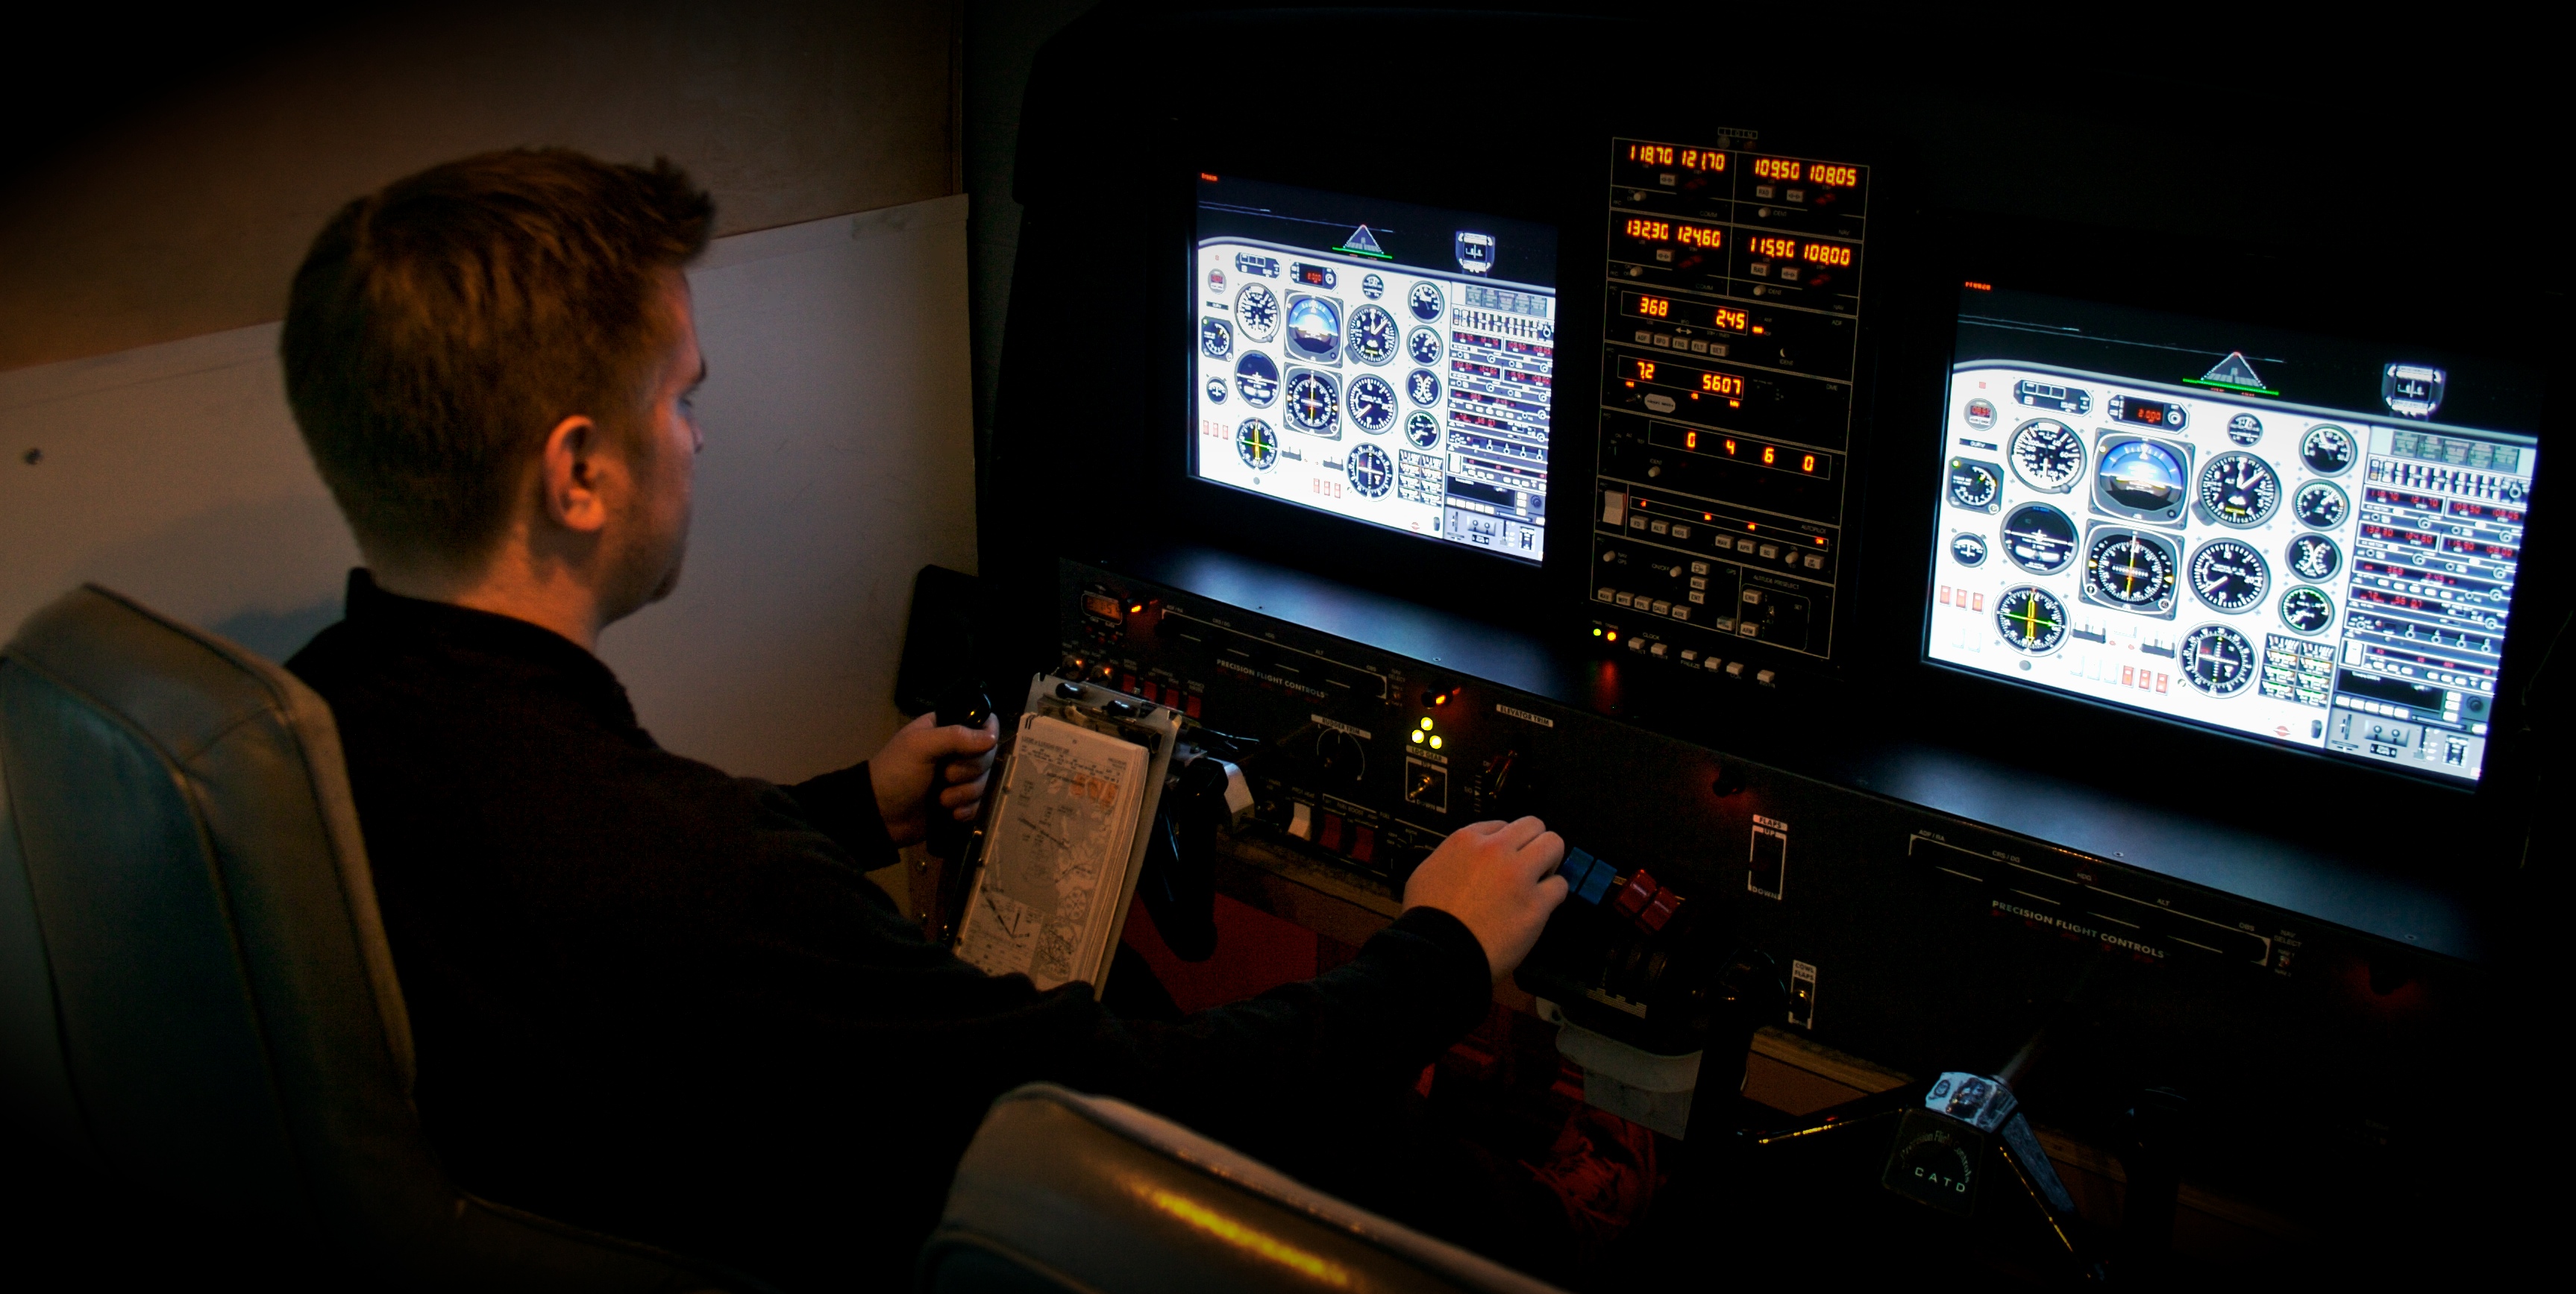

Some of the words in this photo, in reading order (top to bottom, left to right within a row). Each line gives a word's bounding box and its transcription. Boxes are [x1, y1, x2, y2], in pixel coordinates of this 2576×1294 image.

[1640, 296, 1669, 317] 368
[1725, 439, 1736, 455] 4
[1764, 447, 1775, 464] 6
[1804, 455, 1814, 472] 0
[1643, 632, 1660, 641] CLOCK
[1217, 659, 1256, 676] PRECISION
[1256, 671, 1283, 686] FLIGHT
[1284, 679, 1326, 699] CONTROLS
[1500, 705, 1532, 720] ELEVATOR
[1534, 715, 1550, 726] TRIM
[1759, 817, 1781, 829] FLAPS
[2156, 898, 2170, 907] ALT
[1991, 899, 2054, 926] PRECISION
[2055, 918, 2099, 939] FLIGHT
[2100, 932, 2165, 959] CONTROLS
[1795, 970, 1814, 981] FLAPS
[1914, 1166, 1966, 1193] CATD
